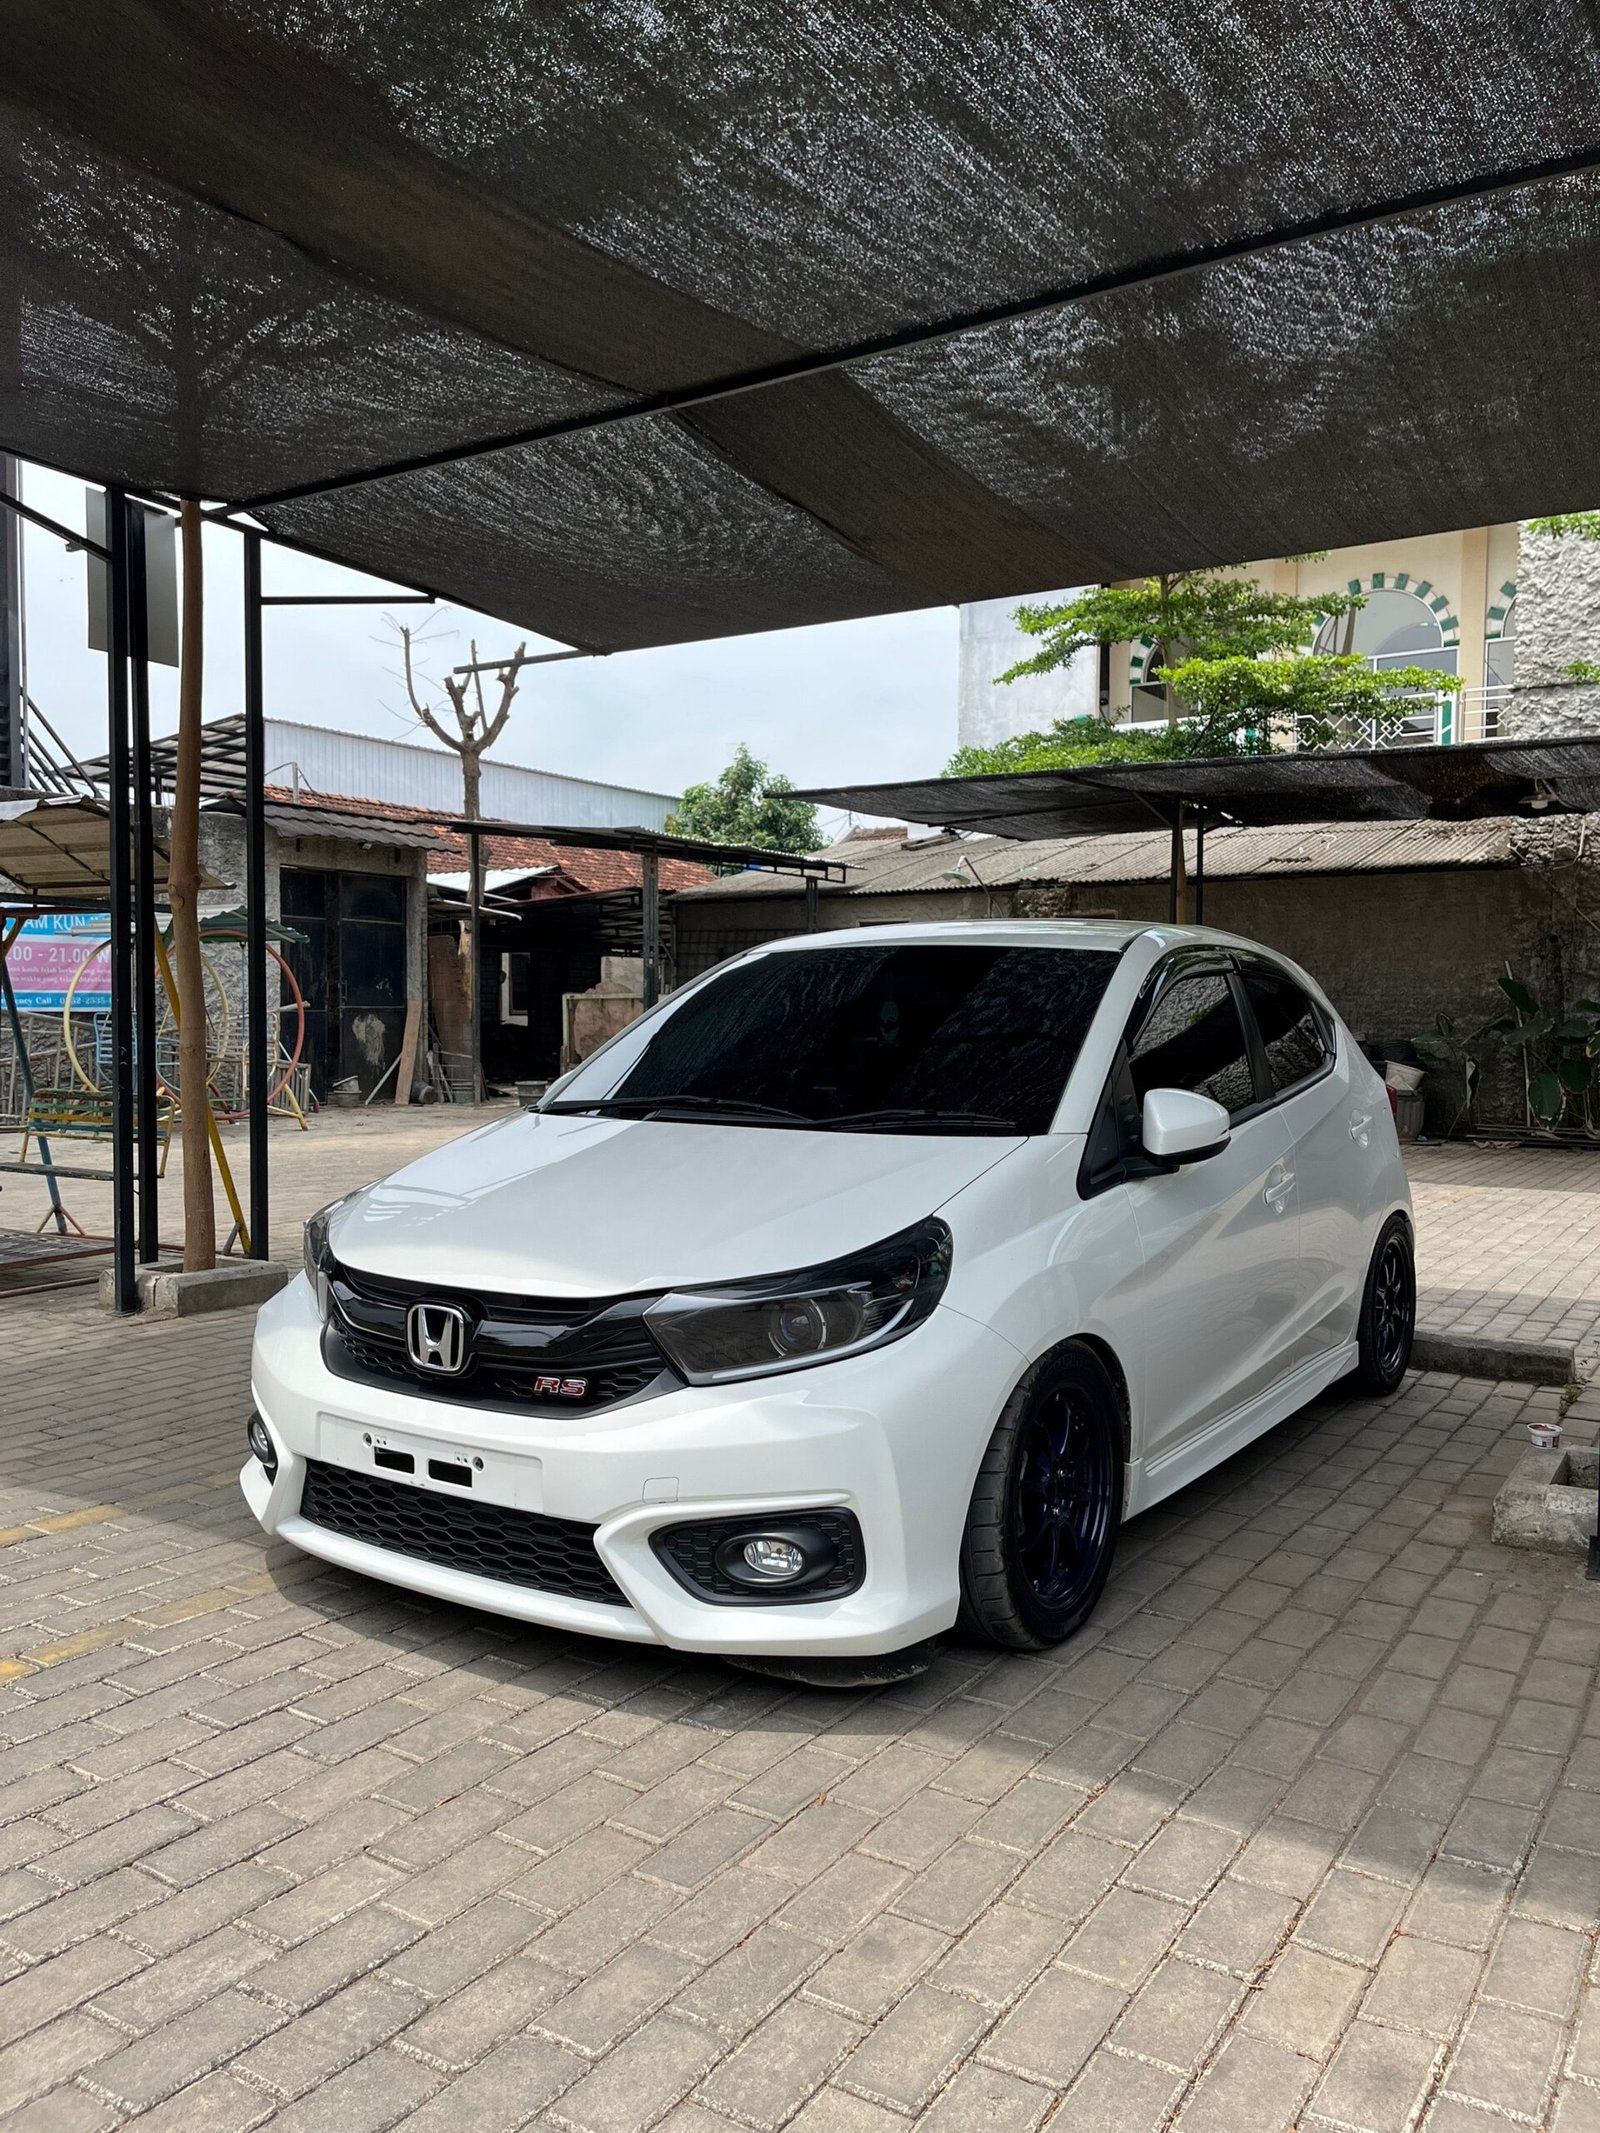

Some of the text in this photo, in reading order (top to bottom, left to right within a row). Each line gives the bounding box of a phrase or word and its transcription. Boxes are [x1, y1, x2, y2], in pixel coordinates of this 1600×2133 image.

[97, 950, 110, 963] W
[36, 996, 52, 1004] Call
[534, 1375, 587, 1397] RS
